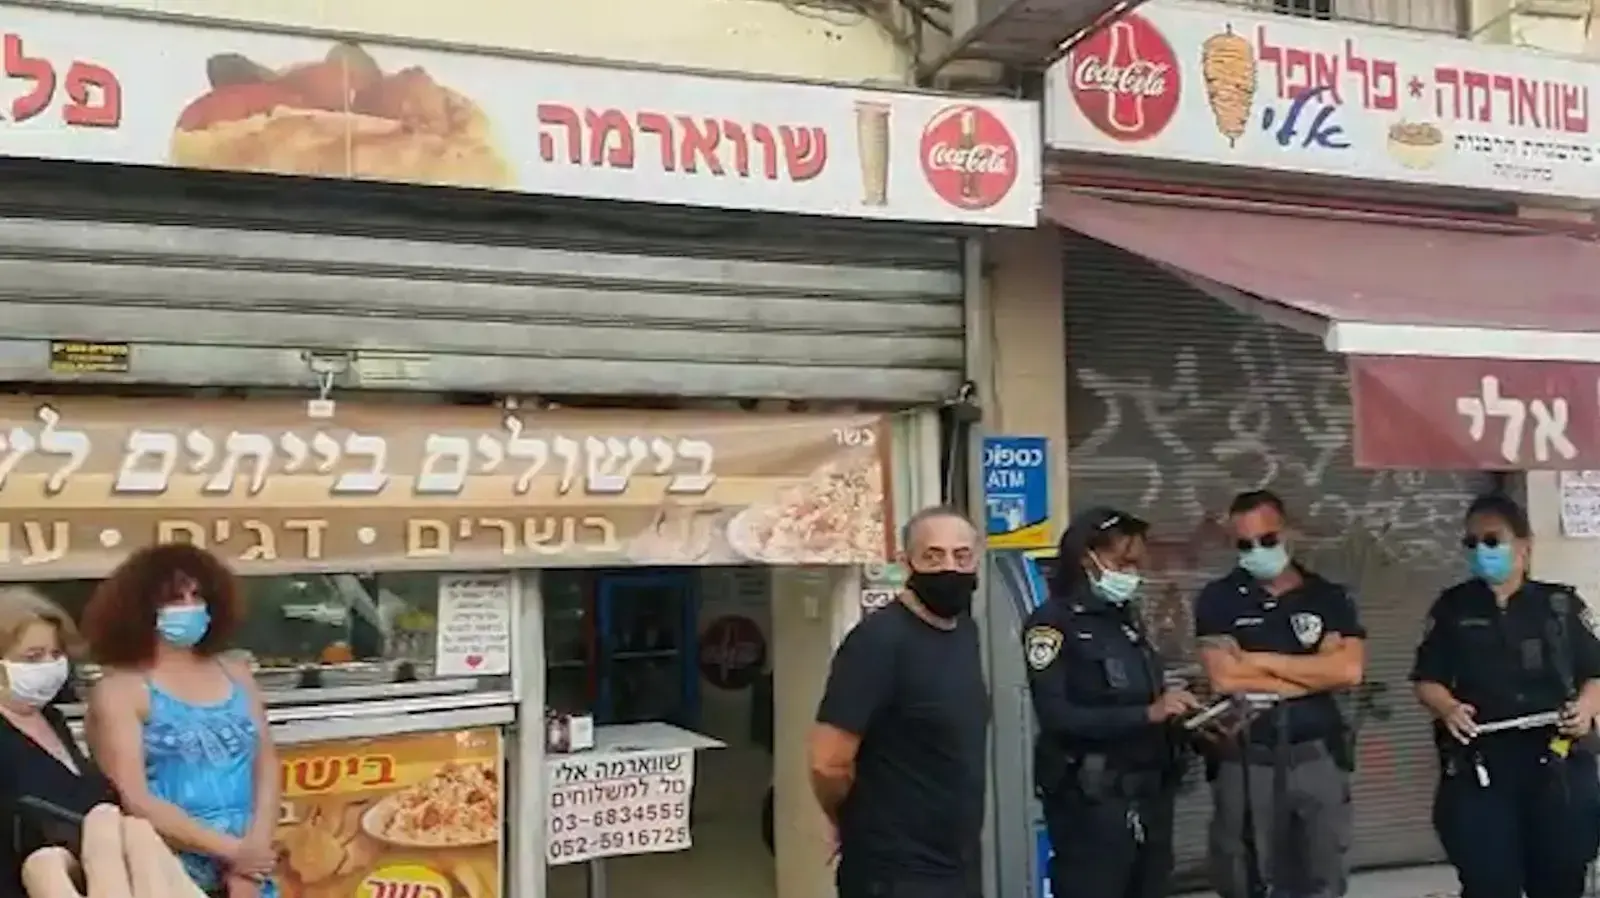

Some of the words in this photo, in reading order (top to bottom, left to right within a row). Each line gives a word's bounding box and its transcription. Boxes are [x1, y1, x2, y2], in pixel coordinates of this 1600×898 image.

[0, 33, 121, 128] פל
[1258, 26, 1399, 110] פלאפל
[1434, 66, 1589, 133] שווארמה
[537, 102, 827, 182] שווארמה
[832, 427, 876, 447] כשר
[1456, 375, 1577, 463] אלי
[113, 429, 390, 494] בייתים
[415, 416, 716, 495] בישולים
[986, 469, 1026, 488] ATM
[405, 515, 623, 558] בשרים
[555, 762, 588, 782] אלי
[595, 755, 682, 779] שווארמה
[552, 779, 650, 808] למשלוחים
[552, 803, 685, 834] 03-6834555
[550, 827, 687, 858] 052-5916725
